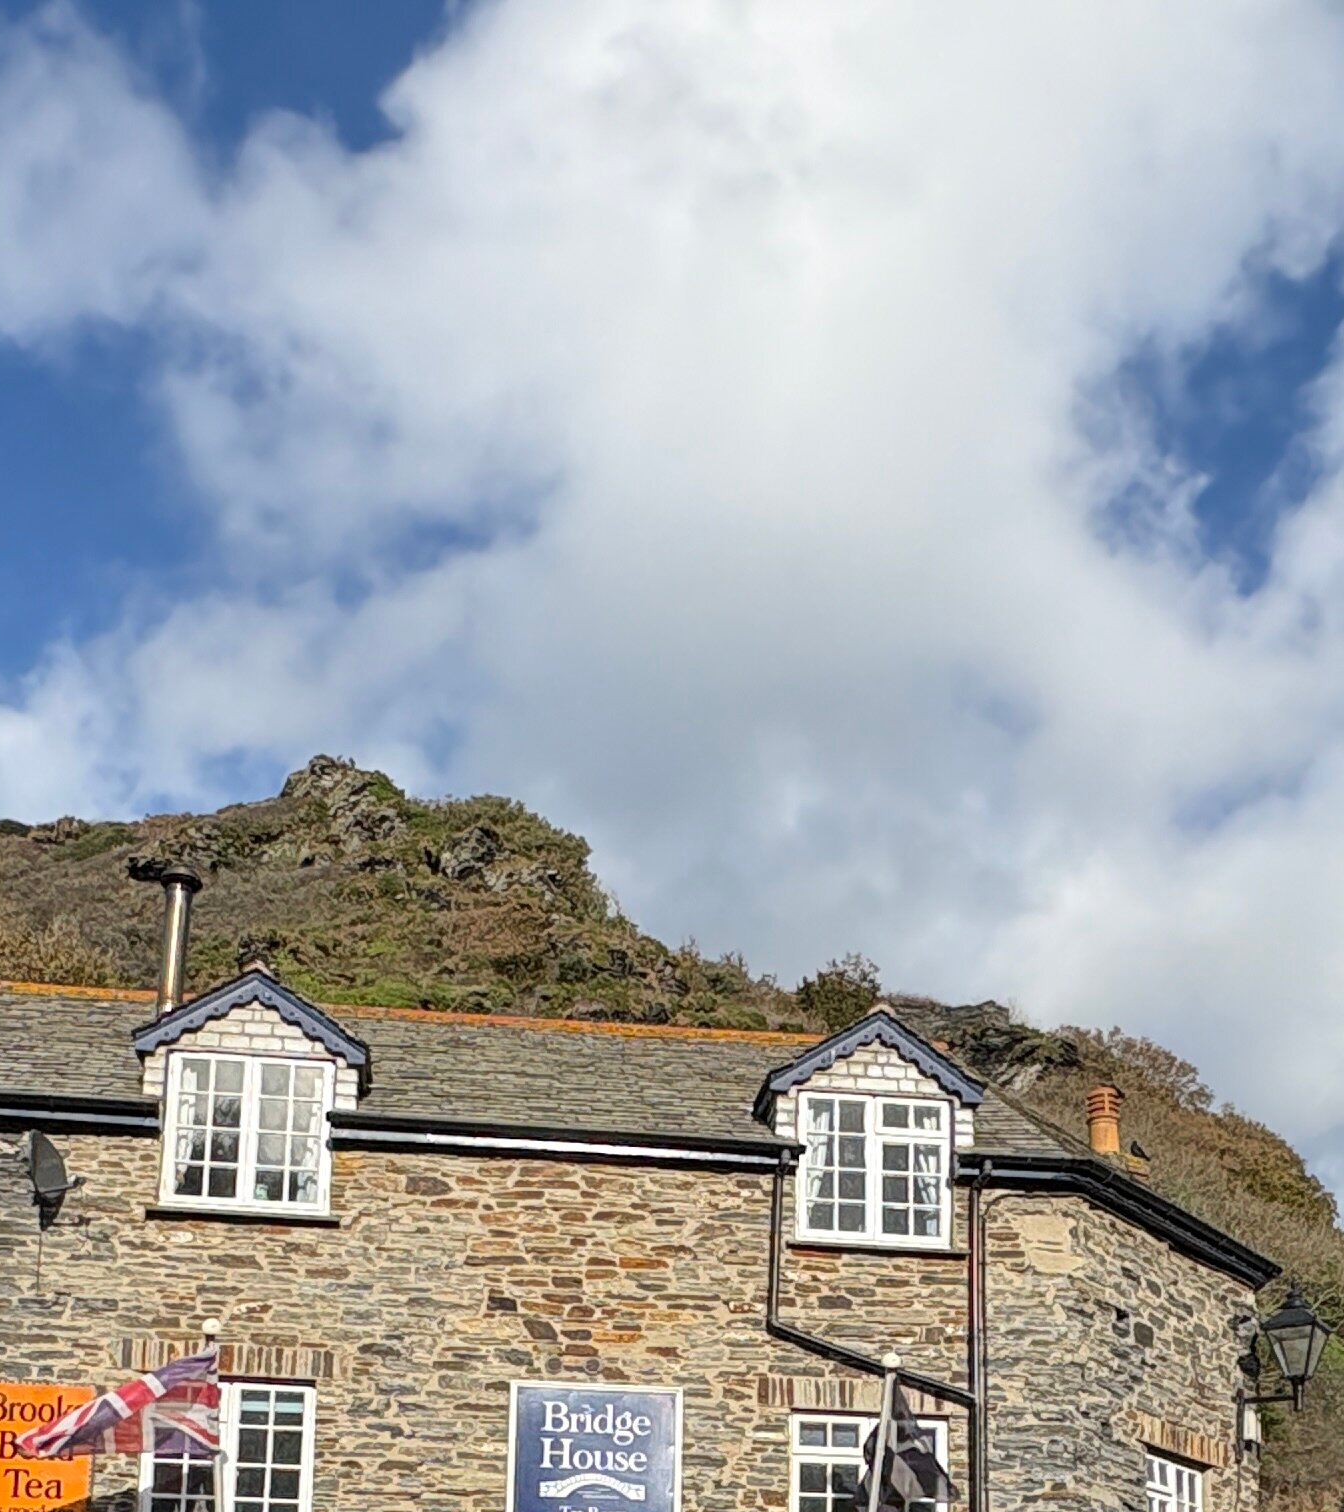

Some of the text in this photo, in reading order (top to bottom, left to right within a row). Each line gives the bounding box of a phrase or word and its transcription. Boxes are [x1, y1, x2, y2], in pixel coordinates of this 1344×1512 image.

[540, 1400, 652, 1447] Bridge
[539, 1436, 648, 1473] House
[3, 1468, 64, 1499] Tea
